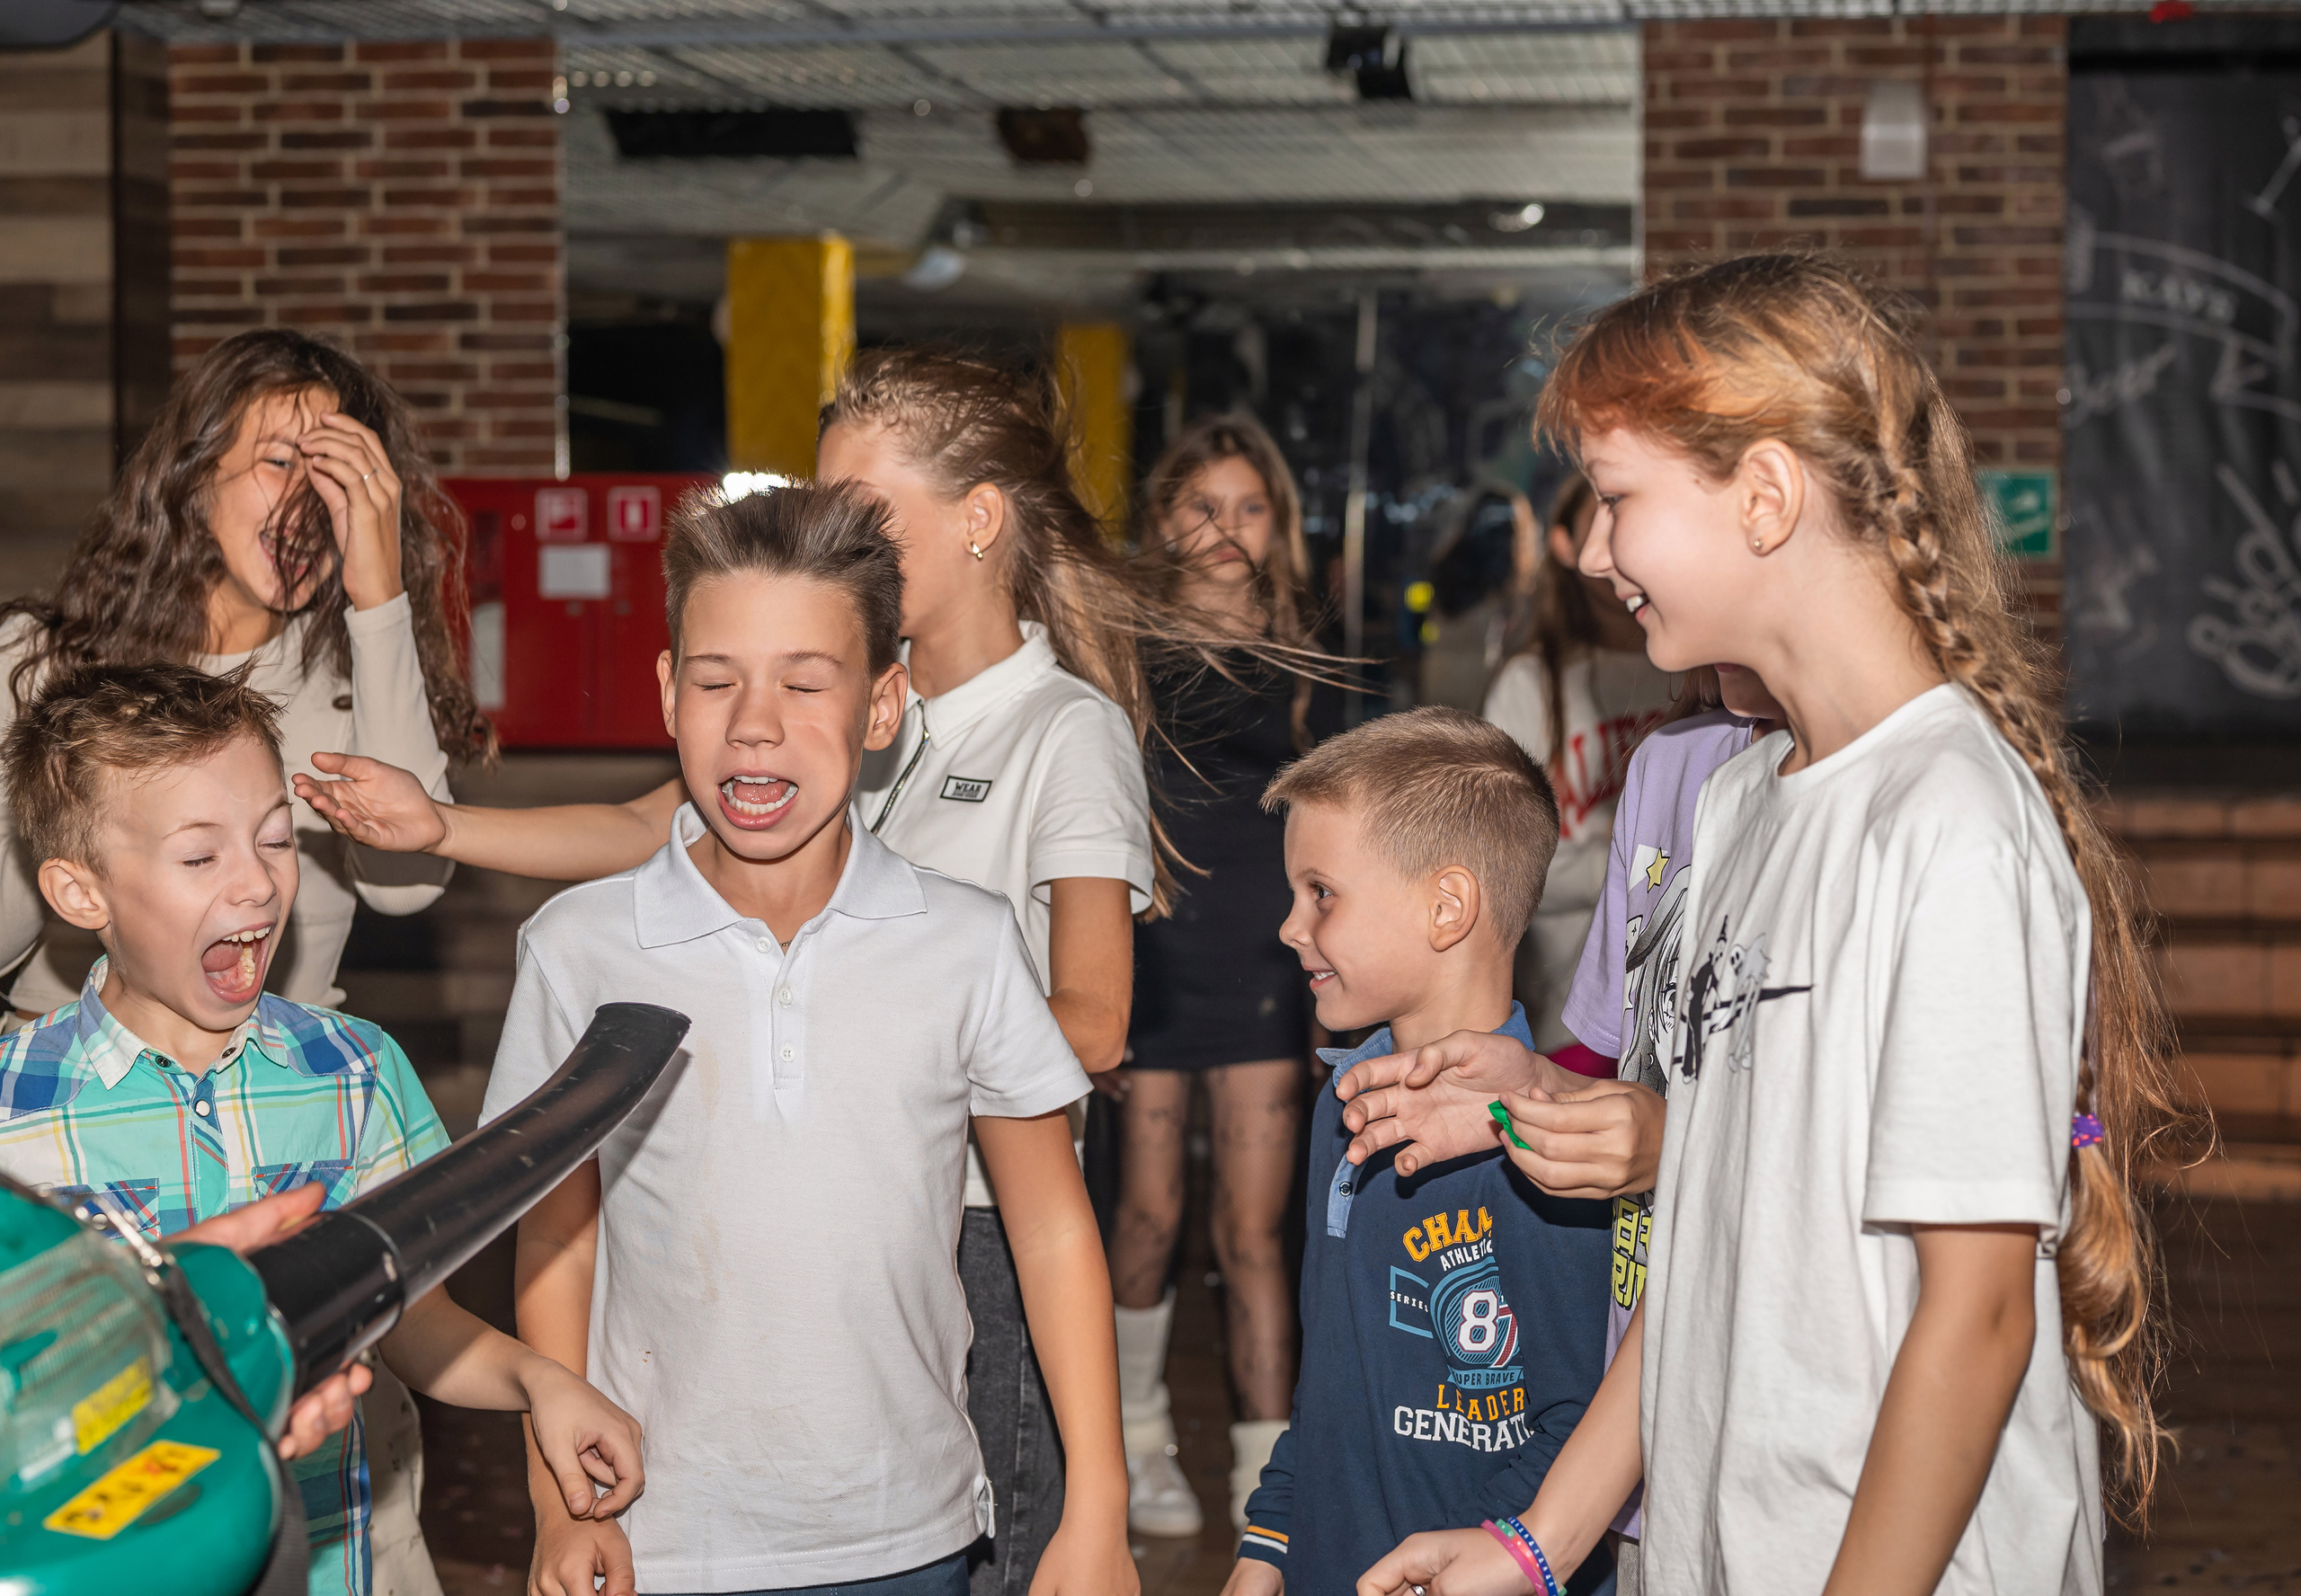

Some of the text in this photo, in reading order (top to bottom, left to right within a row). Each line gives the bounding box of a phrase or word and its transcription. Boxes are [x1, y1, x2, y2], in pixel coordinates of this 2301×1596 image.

[955, 782, 982, 793] WEAR
[1454, 1371, 1515, 1386] UPER BRAVE
[1436, 1384, 1524, 1422] LEADER
